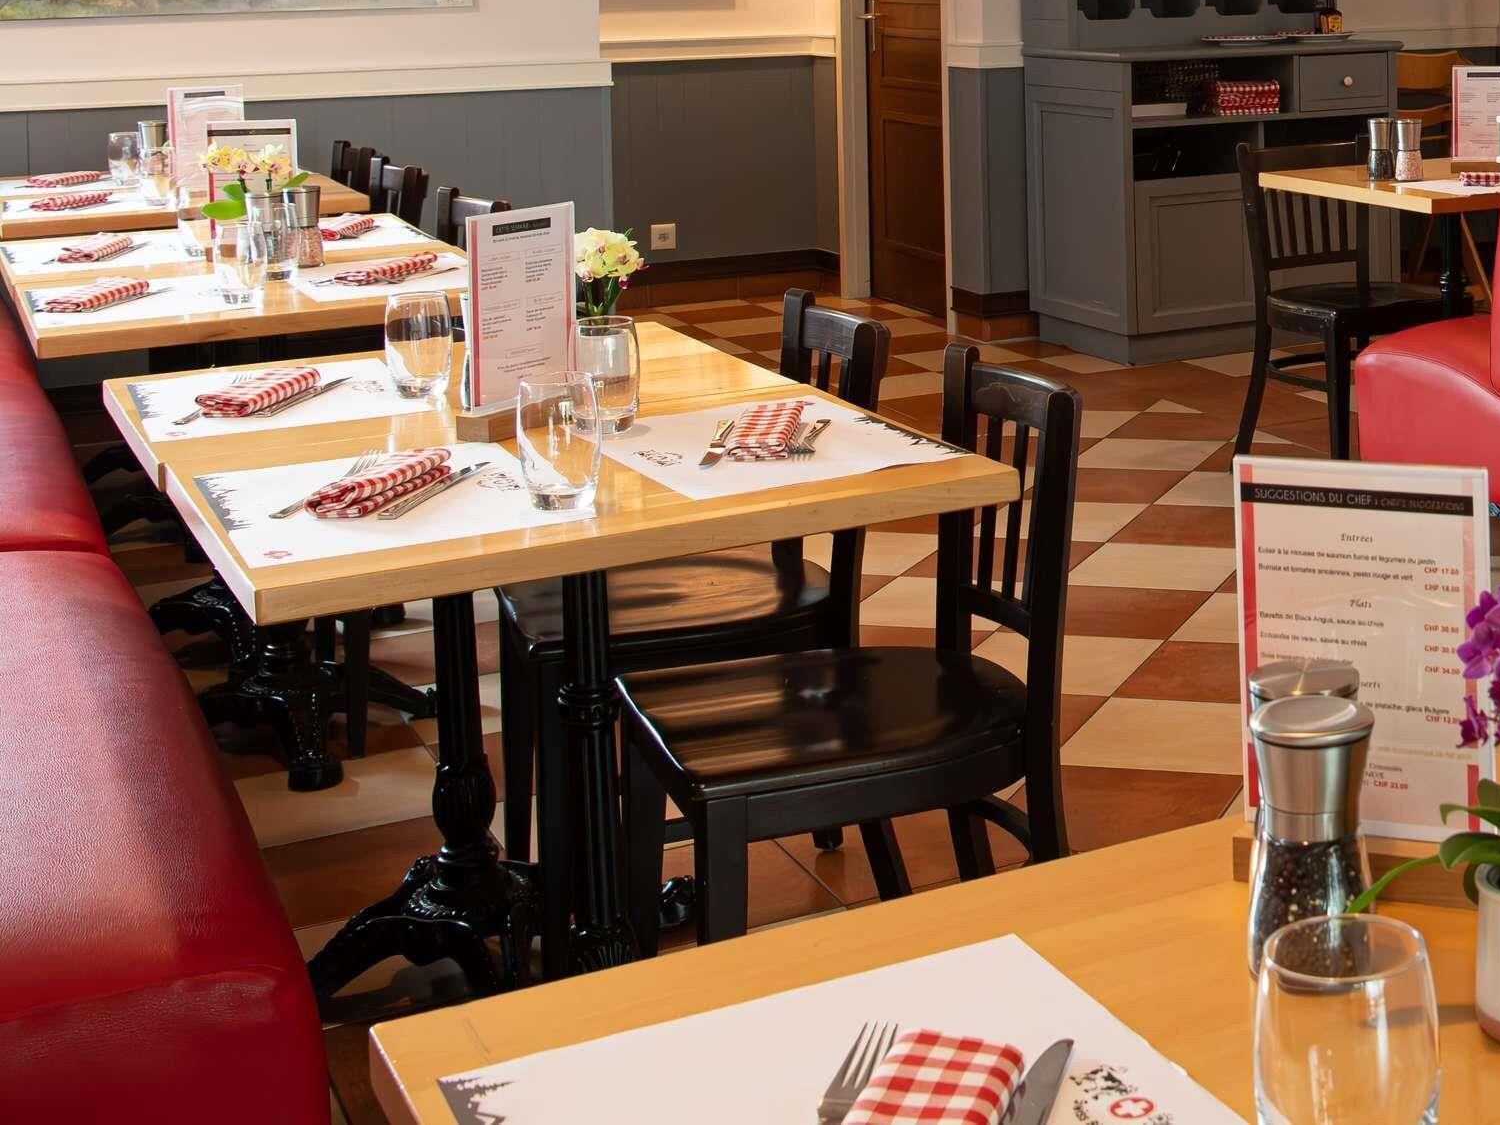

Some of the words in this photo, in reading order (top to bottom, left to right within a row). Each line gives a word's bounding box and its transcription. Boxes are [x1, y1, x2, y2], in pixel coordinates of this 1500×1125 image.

[1254, 488, 1326, 503] SUGGESTIONS
[1328, 492, 1343, 504] DU
[1346, 492, 1372, 506] CHEF
[1424, 566, 1438, 575] CHF
[1424, 583, 1439, 592] CHF
[1424, 623, 1439, 633] CHF
[1424, 665, 1439, 674] CHF
